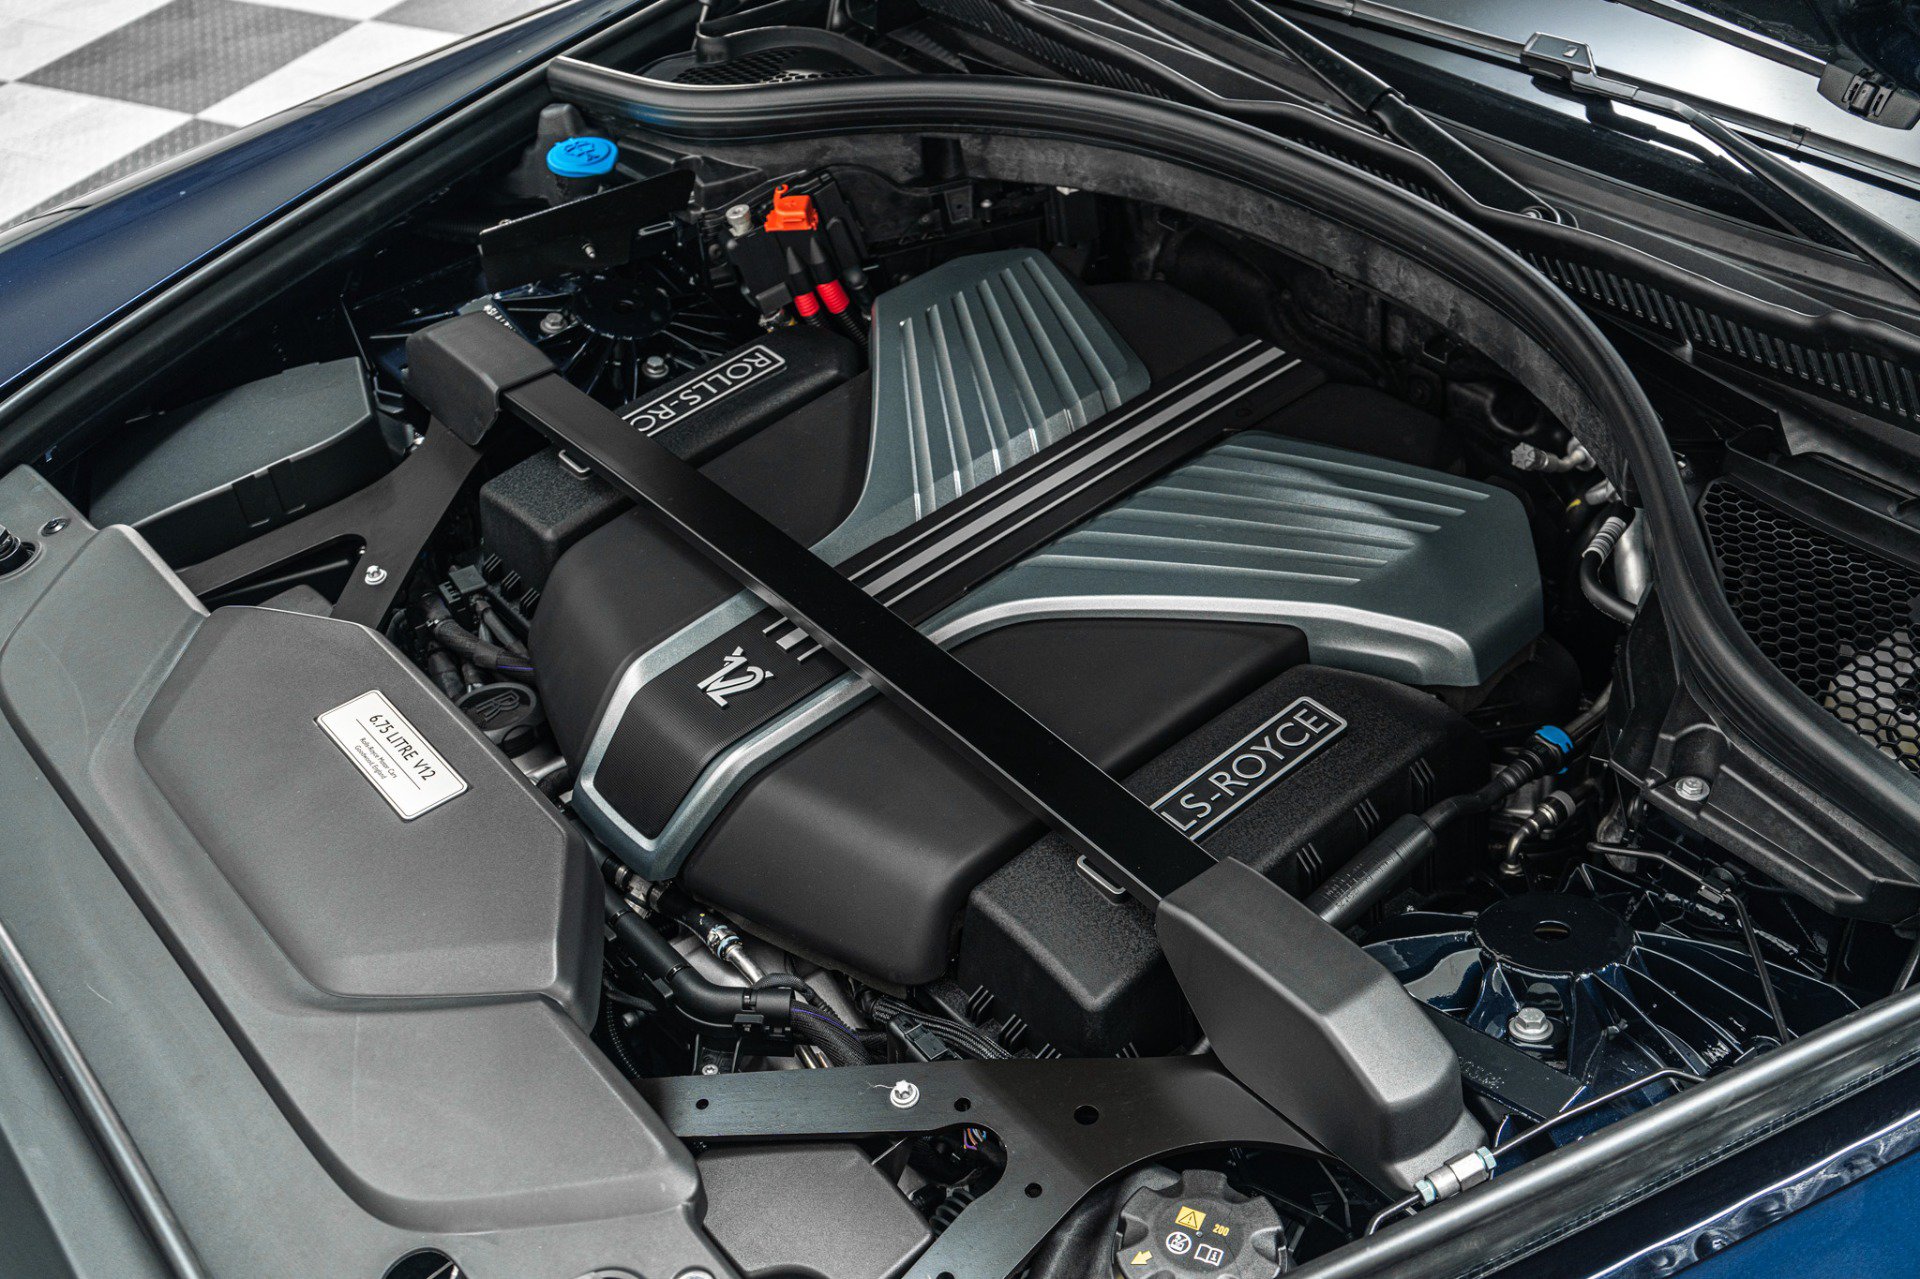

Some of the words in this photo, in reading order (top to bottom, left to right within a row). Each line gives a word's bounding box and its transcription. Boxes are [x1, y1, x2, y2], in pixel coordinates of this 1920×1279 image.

[369, 714, 394, 734] 6.75
[386, 731, 418, 761] LITRE
[413, 758, 436, 781] V12
[1160, 708, 1329, 832] LS-ROYCE
[1212, 1223, 1230, 1237] 200
